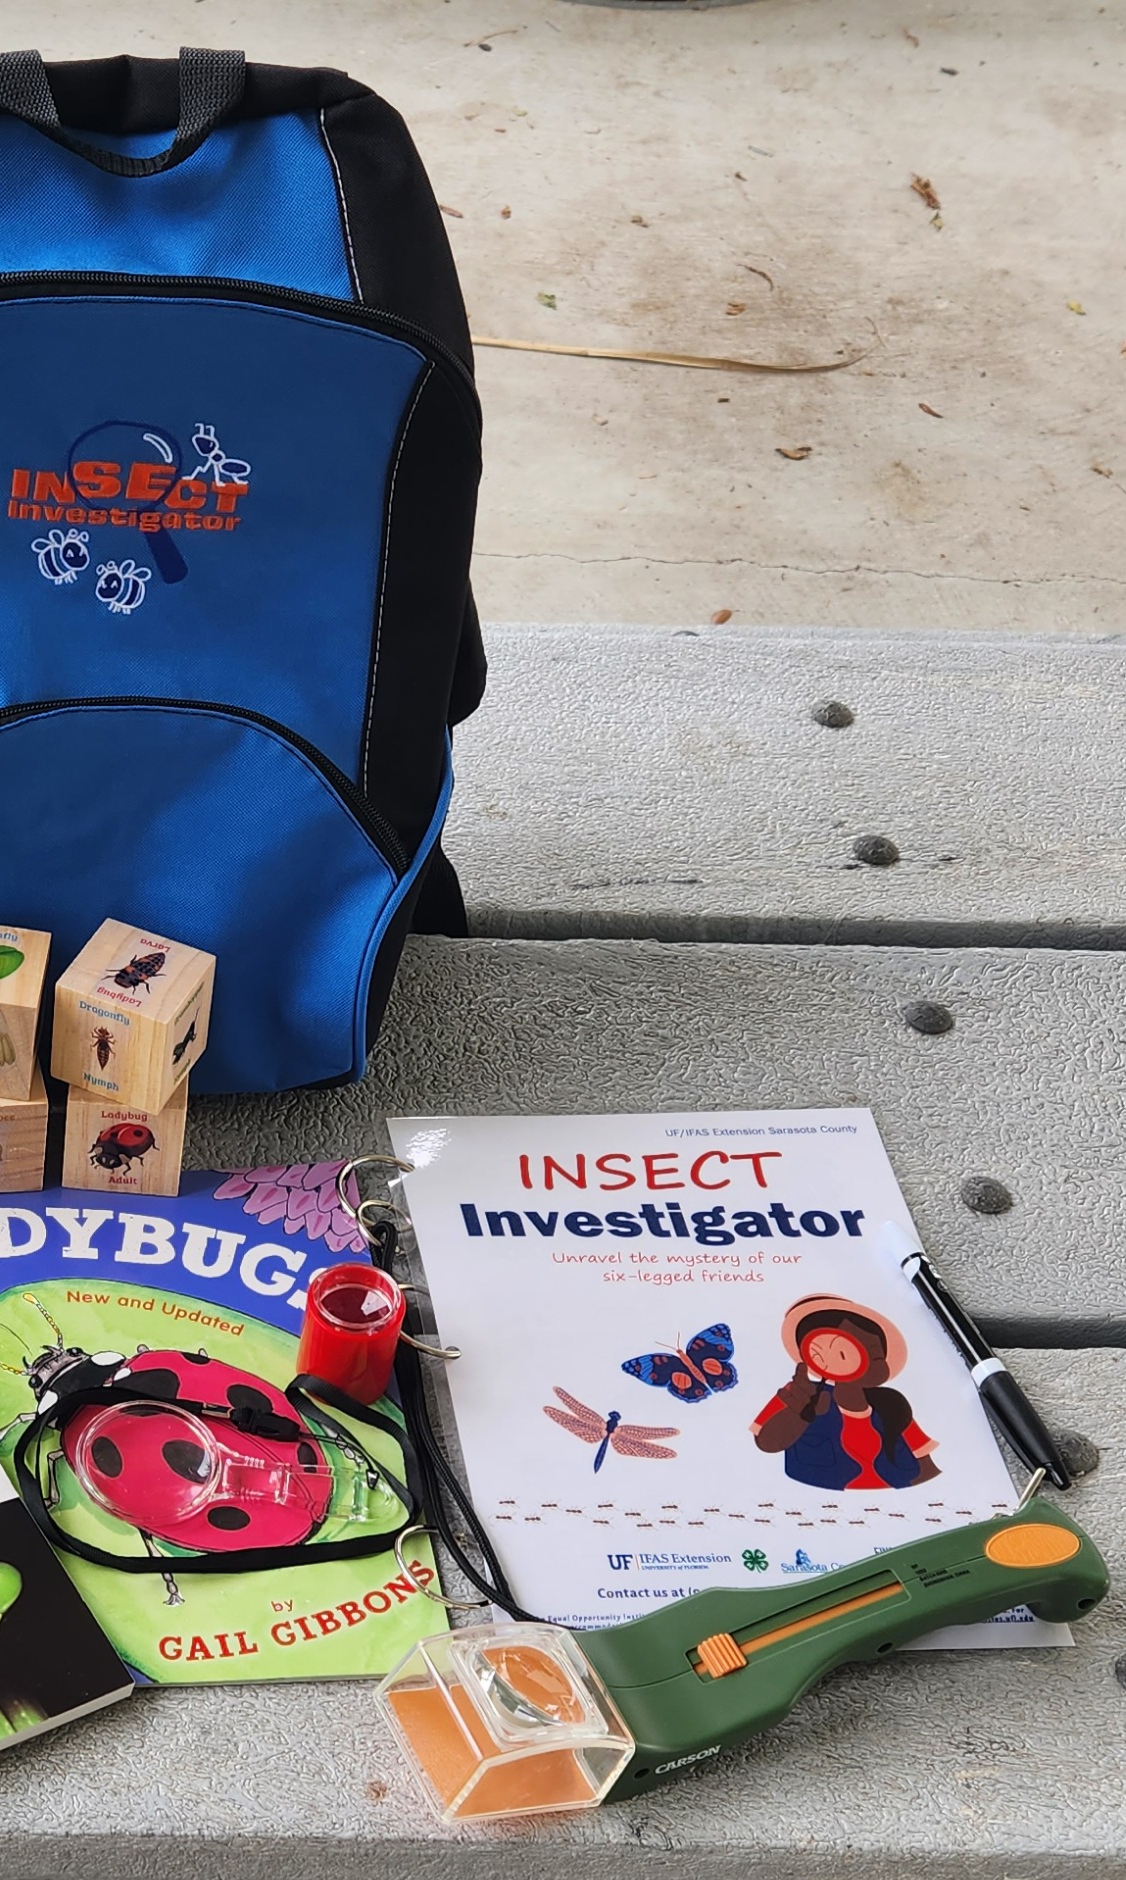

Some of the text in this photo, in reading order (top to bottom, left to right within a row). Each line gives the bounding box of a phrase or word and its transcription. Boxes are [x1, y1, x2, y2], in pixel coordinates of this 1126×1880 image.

[11, 461, 249, 513] INSECT
[8, 500, 241, 533] Investigator
[140, 938, 171, 953] Larva
[97, 986, 142, 1007] Ladybug
[79, 1000, 130, 1026] Dragonfly
[83, 1072, 119, 1092] Nymph
[101, 1110, 148, 1122] Ladybug
[665, 1124, 858, 1138] UF/IFAS Extension Sarasota County
[519, 1150, 782, 1190] INSECT
[108, 1176, 137, 1185] Adult
[460, 1202, 865, 1246] Investigator
[552, 1251, 802, 1267] Unravel the mystery of our
[603, 1269, 764, 1286] six-legged friends
[67, 1290, 245, 1337] New and Updated
[607, 1554, 633, 1570] UF
[639, 1553, 669, 1564] IFAS
[671, 1553, 732, 1564] Extension
[780, 1563, 827, 1572] Sarasota
[597, 1587, 651, 1599] Contact
[654, 1589, 668, 1598] us
[671, 1587, 685, 1597] at
[271, 1559, 435, 1648] GIBBONS
[271, 1599, 294, 1613] by
[547, 1614, 570, 1623] Equal
[572, 1613, 621, 1622] Opportunity
[159, 1631, 259, 1661] GAIL
[655, 1744, 722, 1775] CARSON
